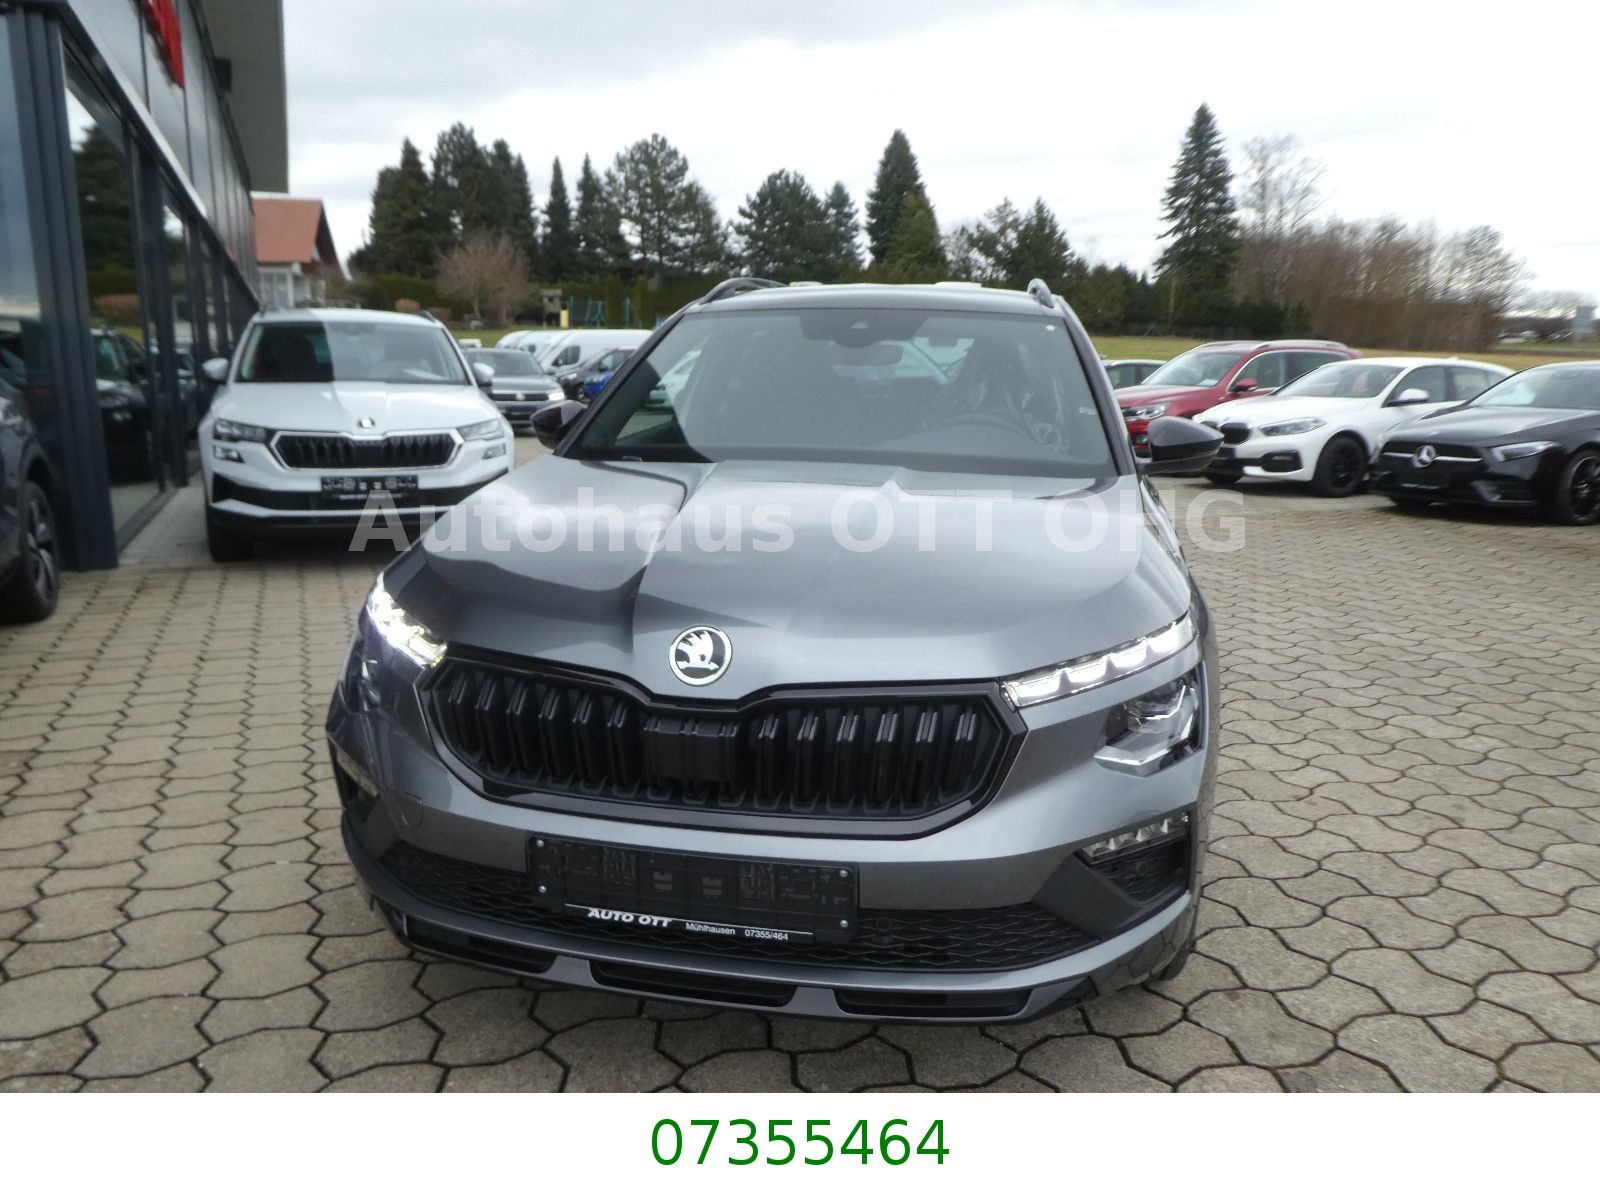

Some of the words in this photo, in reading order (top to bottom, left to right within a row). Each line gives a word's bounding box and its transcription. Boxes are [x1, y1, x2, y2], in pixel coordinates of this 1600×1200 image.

[587, 908, 635, 923] AUTO
[638, 914, 672, 928] OTT
[685, 922, 736, 936] Mühlhausen
[744, 929, 789, 941] 07355/464
